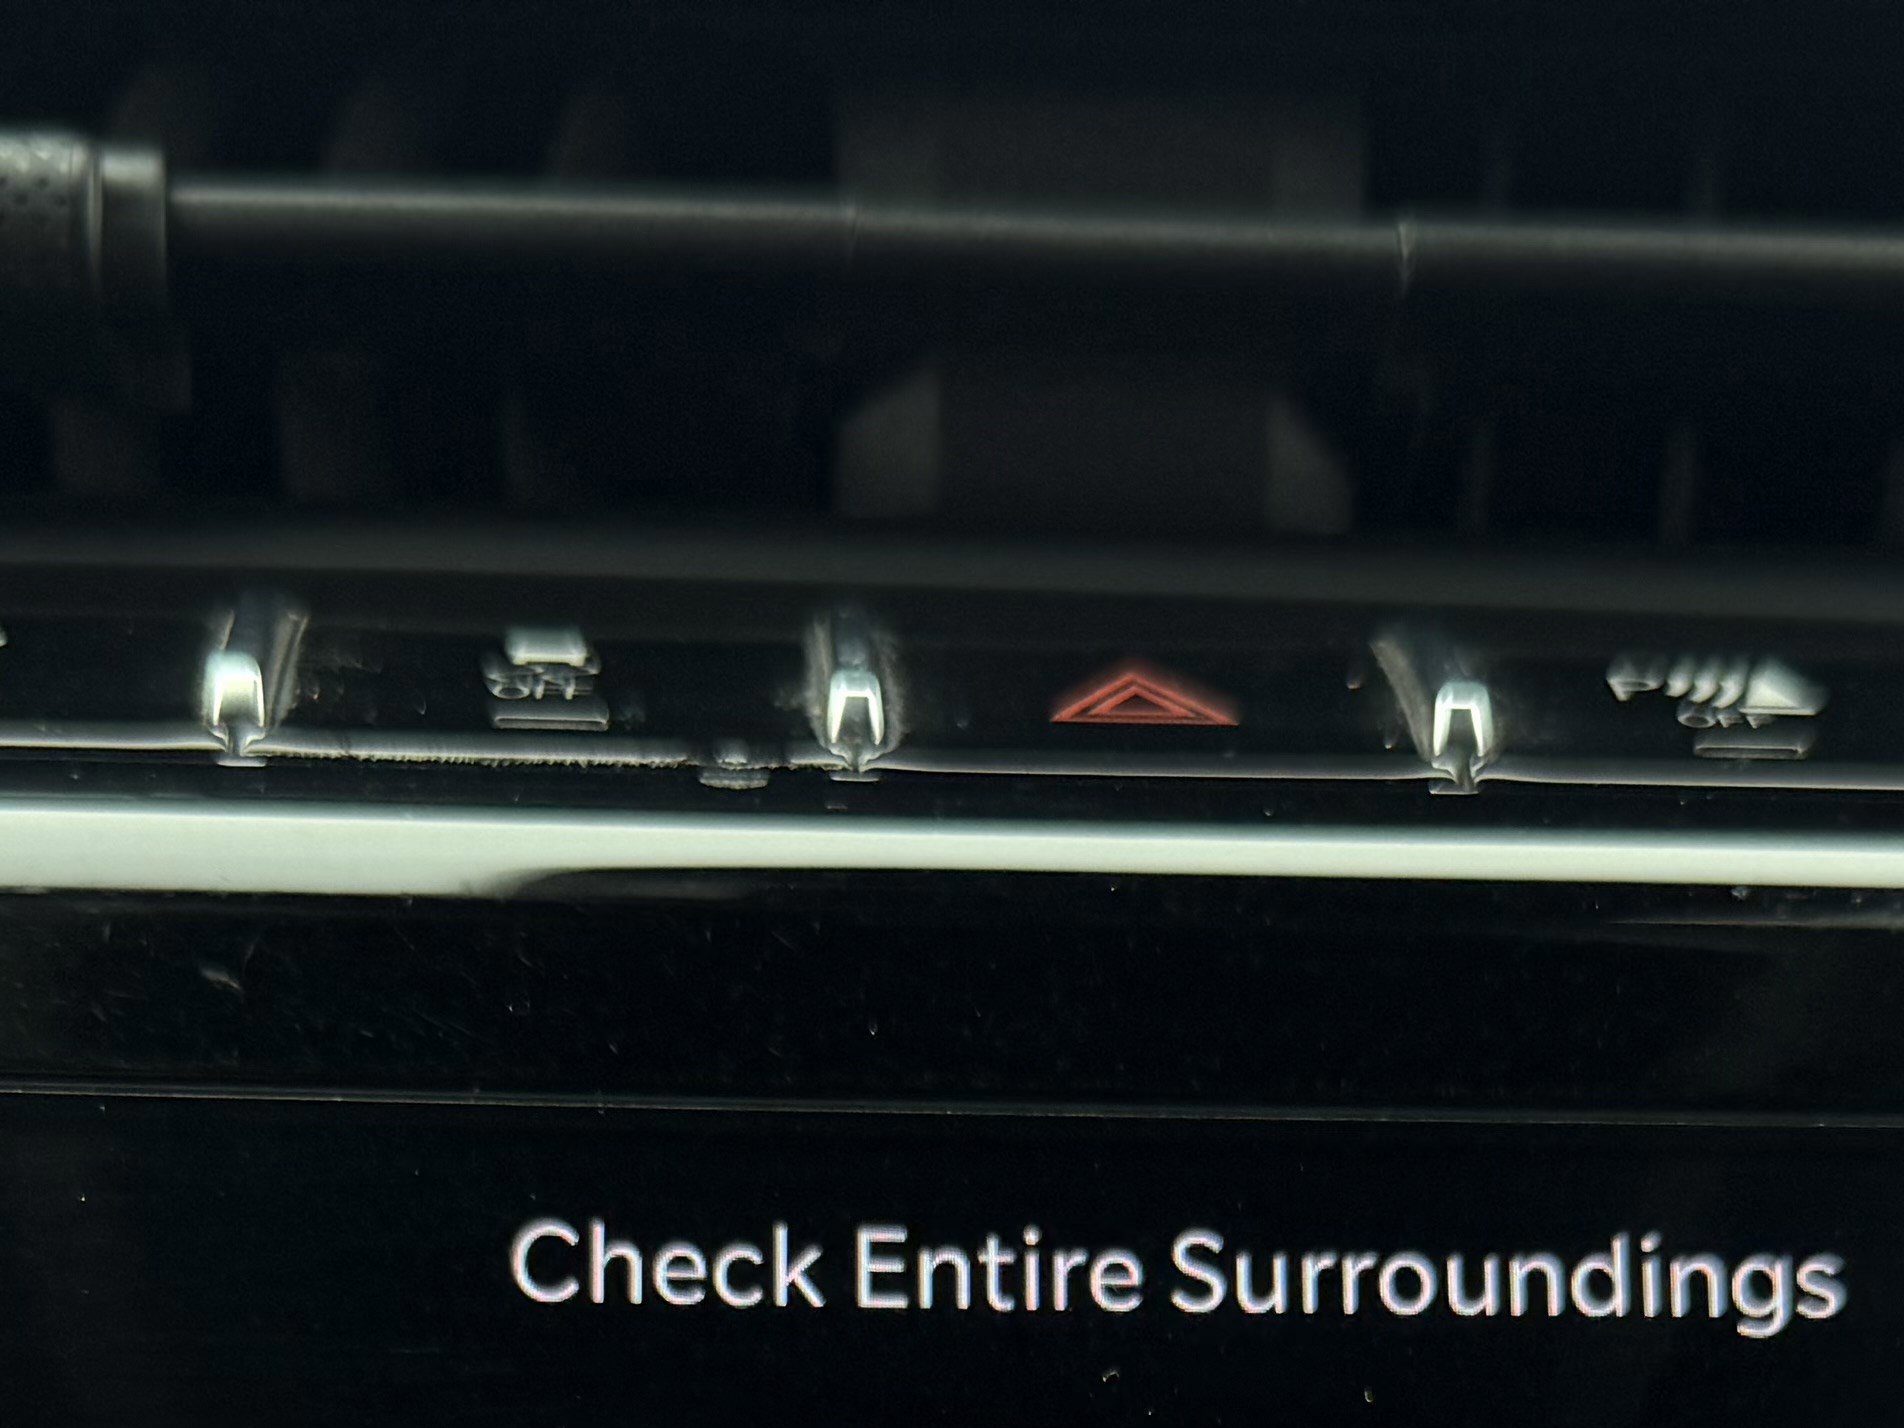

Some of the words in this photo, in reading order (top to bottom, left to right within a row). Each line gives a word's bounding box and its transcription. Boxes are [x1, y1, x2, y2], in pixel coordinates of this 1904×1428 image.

[508, 1217, 828, 1309] Check
[855, 1224, 1145, 1314] Entire
[1169, 1227, 1847, 1340] Surroundings
